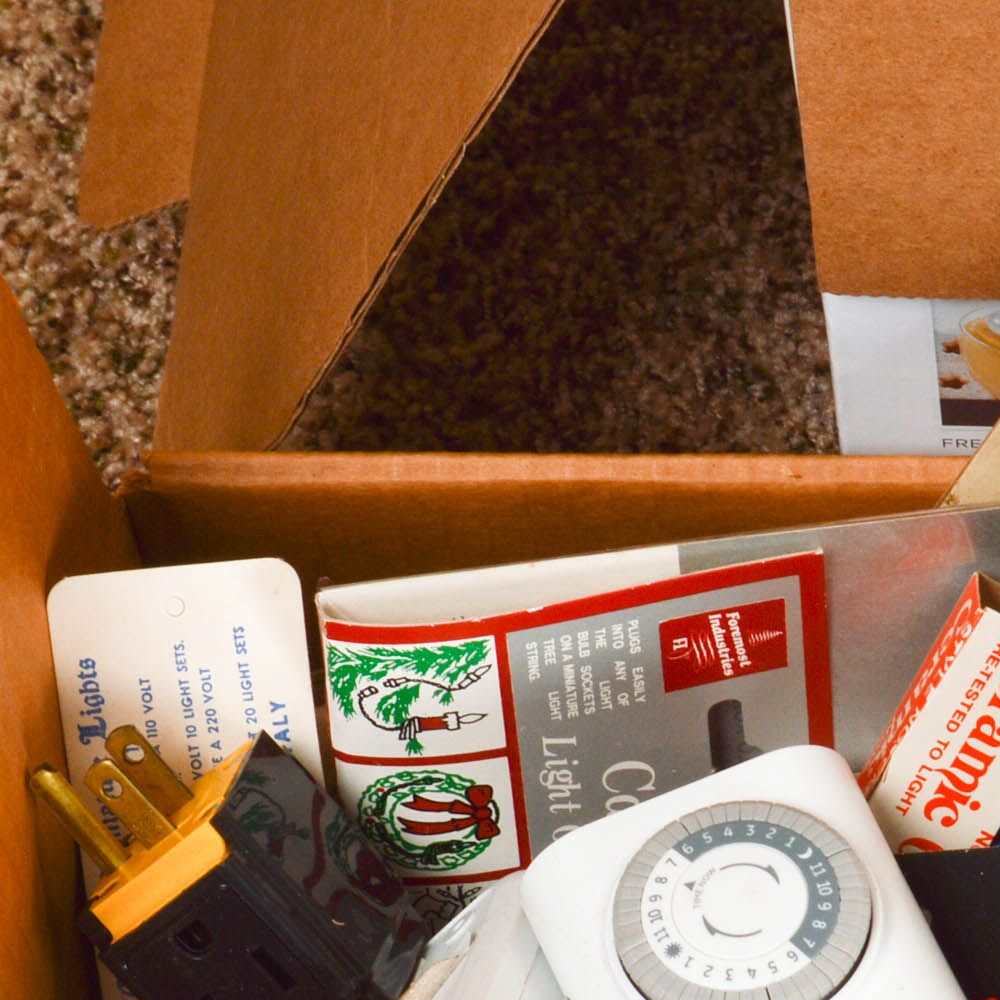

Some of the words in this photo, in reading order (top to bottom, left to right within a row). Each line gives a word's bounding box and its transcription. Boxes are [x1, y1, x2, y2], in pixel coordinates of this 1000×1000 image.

[232, 625, 247, 654] SETS
[559, 634, 572, 651] ON
[577, 631, 591, 658] BULB
[595, 628, 607, 649] THE
[611, 623, 625, 650] INTO
[628, 619, 642, 655] PLUGS
[708, 613, 734, 677] Industries
[726, 611, 751, 668] Foremost
[174, 640, 188, 673] SETS.
[542, 639, 556, 665] TREE
[562, 653, 573, 662] A
[613, 661, 627, 681] ANY
[199, 668, 214, 703] VOLT
[237, 662, 255, 702] LIGHT
[580, 665, 596, 716] SOCKETS
[632, 666, 647, 703] EASILY
[77, 658, 107, 746] Lights
[139, 677, 153, 714] VOLT
[178, 680, 195, 721] LIGHT
[599, 681, 613, 712] LIGHT
[617, 692, 629, 706] OF
[243, 707, 258, 725] 20
[548, 691, 562, 721] LIGHT
[145, 720, 159, 739] 110
[205, 708, 219, 733] 220
[269, 700, 292, 750] ALY
[184, 724, 198, 739] 10
[211, 740, 223, 751] A
[929, 740, 949, 760] TO
[188, 745, 205, 781] VOLT
[540, 735, 582, 815] Light
[895, 763, 933, 816] LIGHT
[703, 832, 713, 843] 5
[724, 827, 733, 837] 4
[746, 825, 755, 836] 3
[765, 828, 777, 839] 2
[682, 843, 694, 855] 6
[786, 837, 795, 848] 1
[809, 862, 827, 877] 11
[816, 880, 833, 896] 10
[647, 909, 663, 922] 10
[817, 901, 832, 912] 9
[653, 926, 670, 943] 11
[812, 919, 827, 930] 8
[683, 956, 695, 968] 1
[703, 964, 714, 977] 2
[768, 961, 778, 974] 5
[725, 969, 734, 981] 3
